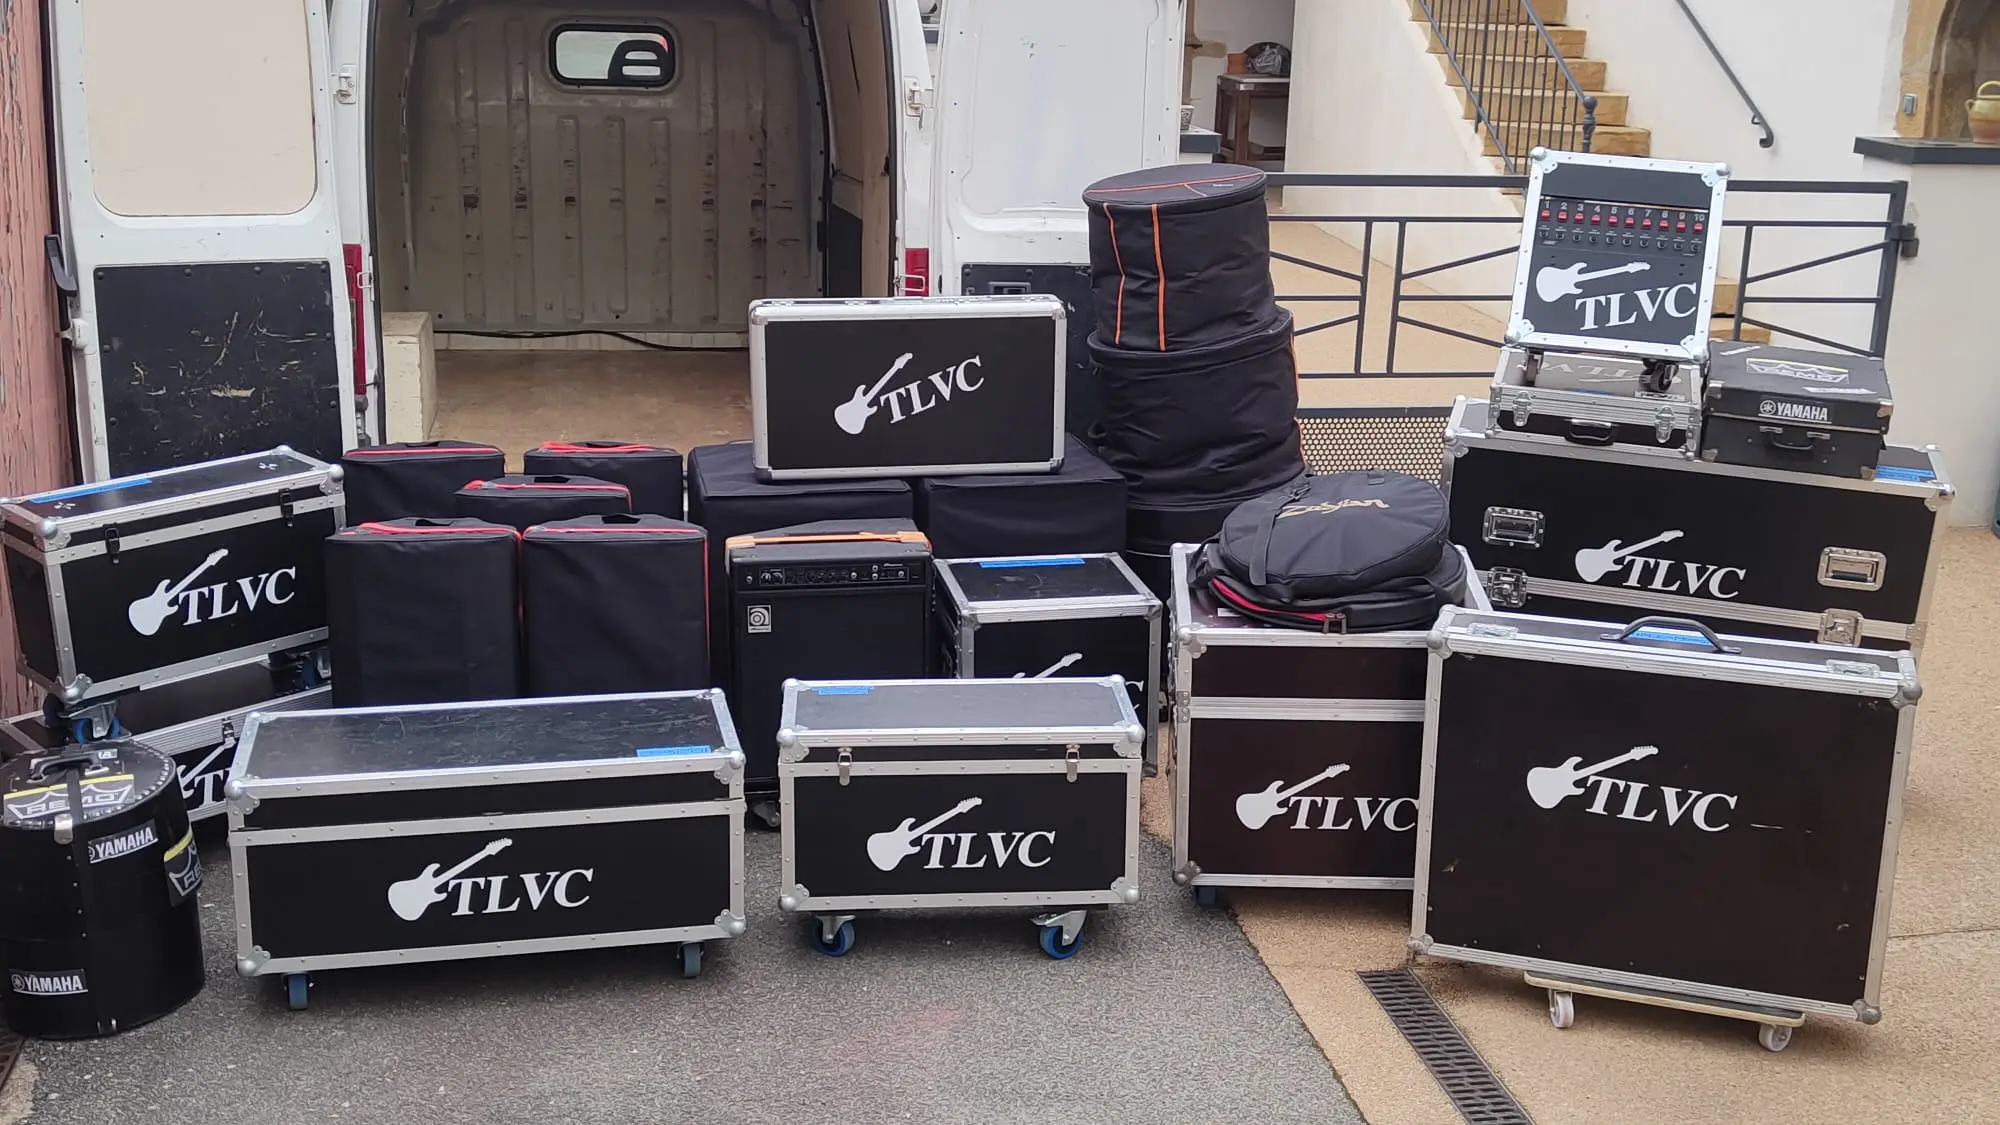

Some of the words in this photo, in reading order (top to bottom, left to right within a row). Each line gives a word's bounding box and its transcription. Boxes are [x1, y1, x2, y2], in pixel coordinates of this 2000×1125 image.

[1560, 202, 1568, 210] 2
[1577, 203, 1584, 211] 3
[1593, 205, 1600, 213] 4
[1611, 206, 1618, 214] 5
[1628, 208, 1635, 216] 6
[1645, 209, 1652, 217] 7
[1662, 210, 1669, 218] 8
[1679, 212, 1686, 220] 9
[1694, 213, 1705, 222] 10
[1574, 282, 1697, 331] TLVC
[879, 355, 985, 424] TLVC
[1777, 402, 1829, 421] YAMAHA
[179, 566, 296, 626] TLVC
[1623, 556, 1746, 599] TLVC
[1289, 797, 1419, 832] TLVC
[1586, 776, 1738, 832] TLVC
[95, 826, 154, 858] YAMAHA
[922, 831, 1056, 869] TLVC
[448, 868, 594, 916] TLVC
[24, 975, 83, 992] YAMAHA
